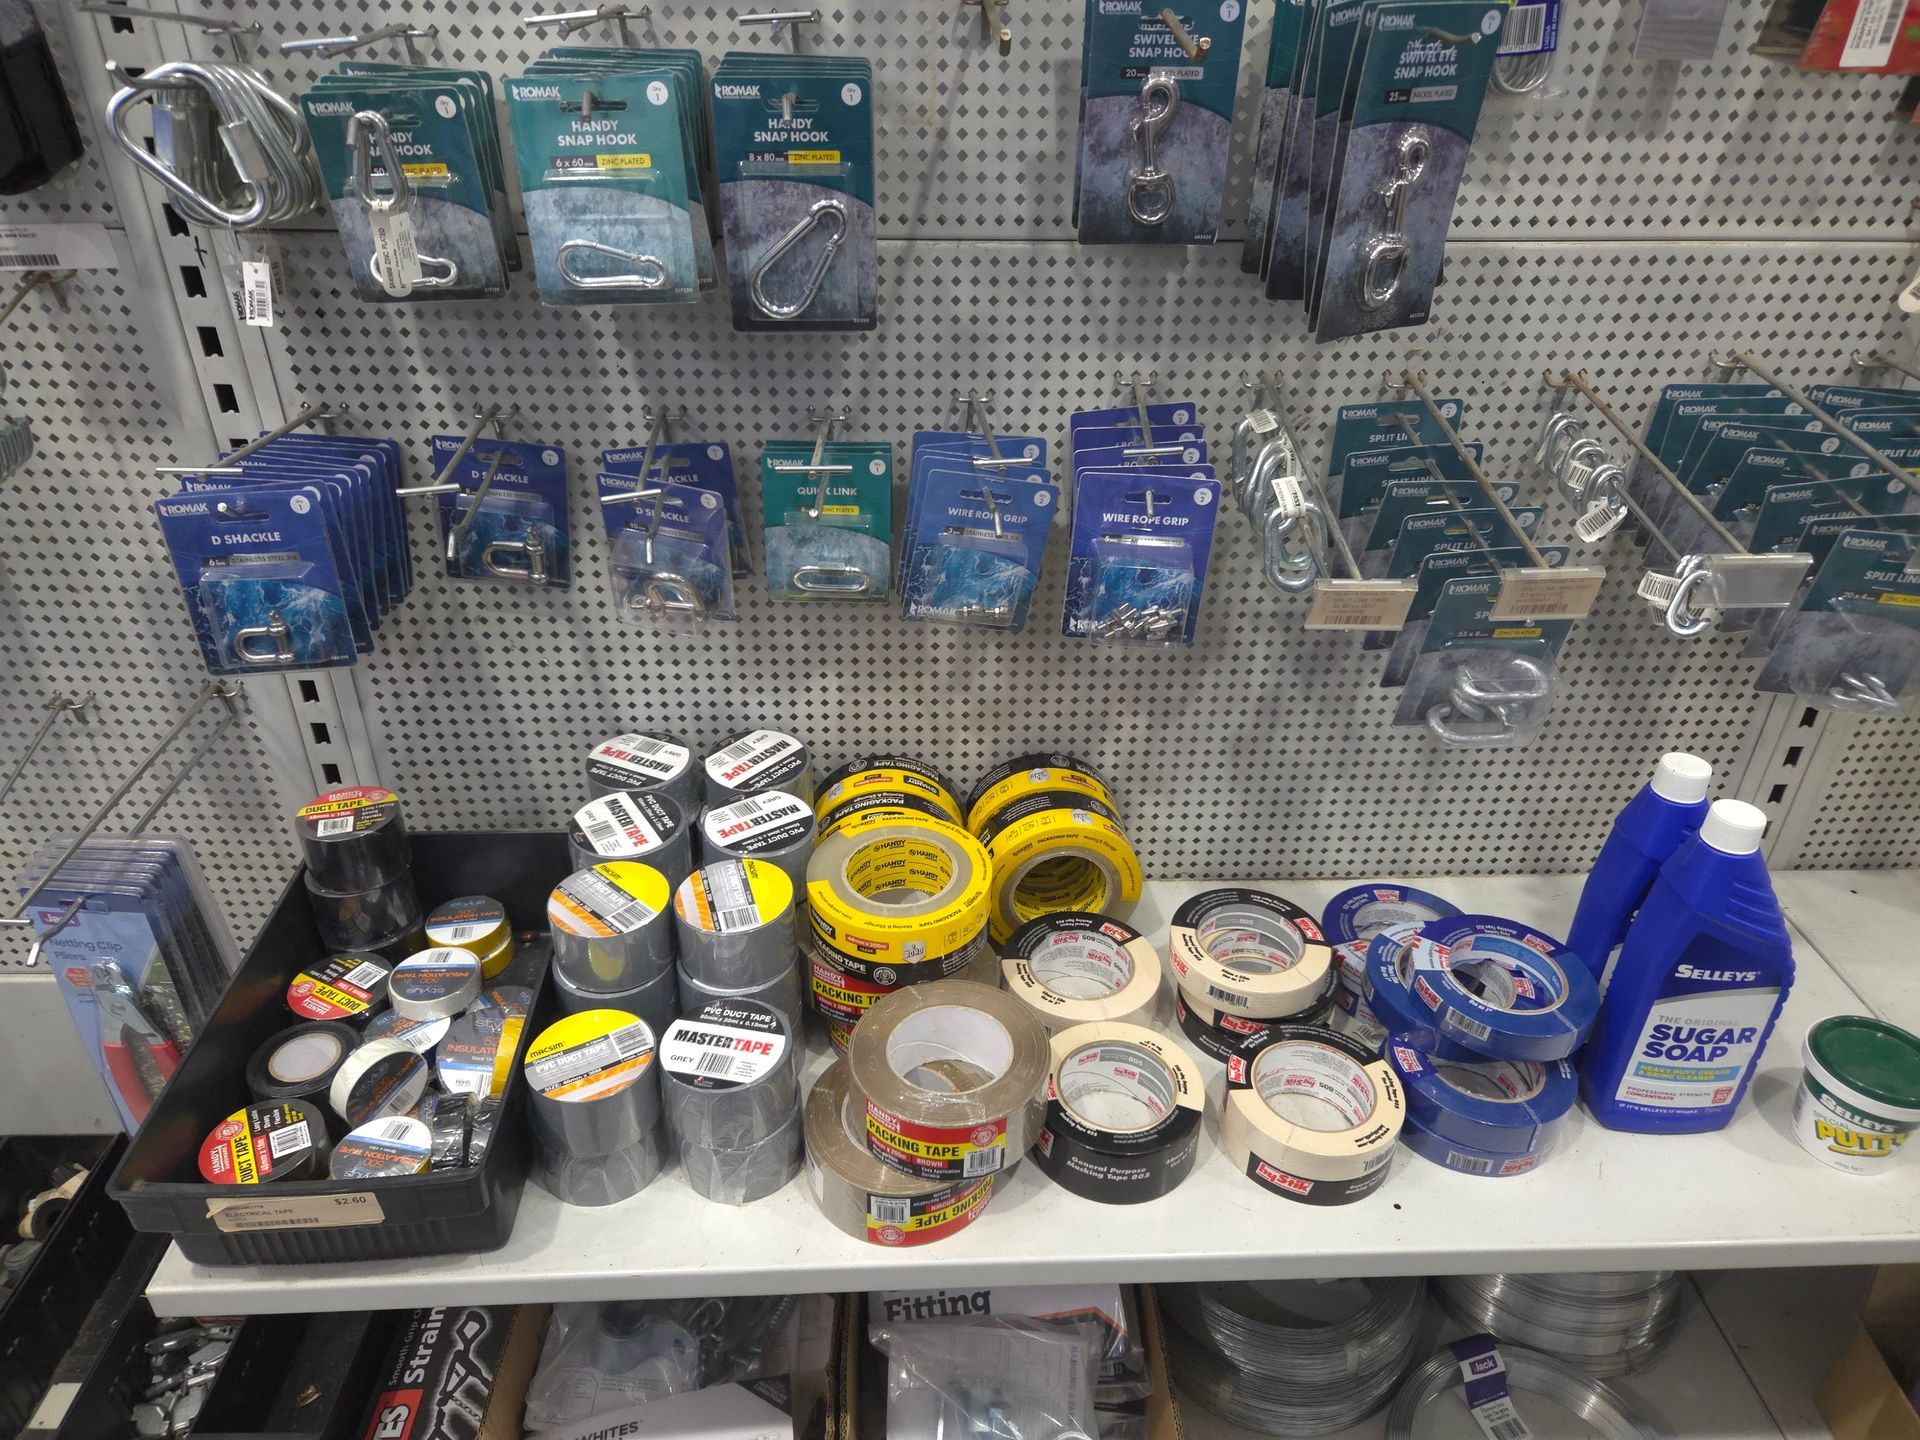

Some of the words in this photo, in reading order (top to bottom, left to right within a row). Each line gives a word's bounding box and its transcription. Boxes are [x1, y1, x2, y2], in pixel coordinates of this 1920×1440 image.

[1106, 1, 1142, 12] ROMAK
[1384, 14, 1416, 29] ROMAK
[1134, 34, 1176, 45] SWIVEL
[1129, 48, 1160, 58] SNAP
[1400, 51, 1439, 63] SWIVEL
[1440, 50, 1457, 62] EYE
[1395, 65, 1424, 79] SNAP
[1425, 64, 1458, 76] HOOK
[520, 86, 561, 98] ROMAK
[722, 85, 761, 96] ROMAK
[316, 102, 355, 115] ROMAK
[572, 120, 620, 132] HANDY
[768, 118, 814, 130] HANDY
[558, 135, 594, 147] SNAP
[597, 133, 638, 145] HOOK
[754, 131, 788, 142] SNAP
[791, 131, 830, 142] HOOK
[394, 144, 433, 155] HOOK
[621, 157, 646, 166] PLATED
[812, 153, 835, 161] PLATED
[1671, 390, 1703, 399] ROMAK
[1830, 396, 1863, 407] ROMAK
[1347, 408, 1378, 418] ROMAK
[1684, 405, 1718, 415] ROMAK
[1859, 421, 1893, 431] ROMAK
[1369, 433, 1395, 443] SPLIT
[1727, 429, 1760, 441] ROMAK
[613, 452, 643, 462] ROMAK
[1878, 449, 1904, 458] SPLIT
[773, 458, 804, 466] ROMAK
[1356, 455, 1390, 466] ROMAK
[1754, 455, 1788, 466] ROMAK
[471, 470, 480, 479] D
[833, 487, 858, 496] LINK
[1395, 486, 1431, 496] ROMAK
[1776, 489, 1814, 501] ROMAK
[168, 502, 209, 515] ROMAK
[635, 507, 643, 515] D
[948, 507, 974, 518] WIRE
[1003, 514, 1028, 524] GRIP
[1103, 513, 1130, 523] WIRE
[1132, 515, 1161, 525] ROPE
[1162, 517, 1189, 527] GRIP
[1413, 518, 1447, 529] ROMAK
[211, 535, 221, 545] D
[225, 532, 282, 544] SHACKLE
[1850, 538, 1888, 550] ROMAK
[1434, 557, 1470, 568] ROMAK
[1864, 571, 1897, 580] SPLIT
[1454, 583, 1492, 594] ROMAK
[598, 746, 675, 774] MASTERTAPE
[722, 740, 791, 782] MASTERTAPE
[873, 760, 898, 768] TAPE
[606, 771, 629, 783] DUCT
[627, 777, 642, 786] PVC
[305, 804, 334, 814] DUCT
[336, 800, 363, 811] TAPE
[855, 797, 905, 809] PACKAGING
[651, 801, 665, 817] DUCT
[661, 814, 675, 829] TAPE
[834, 806, 855, 820] TAPE
[603, 797, 651, 848] MASTERTAPE
[717, 804, 802, 839] MASTERTAPE
[787, 826, 804, 836] PVC
[765, 832, 789, 845] DUCT
[881, 840, 906, 849] HANDY
[917, 849, 939, 861] HANDY
[882, 860, 906, 868] HANDY
[917, 871, 939, 881] HANDY
[582, 873, 597, 886] PVC
[594, 880, 611, 895] DUCT
[606, 890, 625, 905] TAPE
[884, 879, 907, 888] HANDY
[476, 910, 501, 918] TAPE
[1239, 918, 1255, 926] 805
[50, 939, 96, 951] Netting
[97, 942, 123, 954] Clip
[843, 959, 867, 972] TAPE
[813, 965, 843, 980] HANDY
[1674, 963, 1758, 982] SELLEYS
[315, 985, 338, 1002] TAPE
[815, 981, 864, 1005] PACKING
[338, 995, 361, 1011] DUCT
[704, 1006, 722, 1016] PVC
[722, 1008, 748, 1019] DUCT
[749, 1012, 772, 1022] TAPE
[1658, 1015, 1682, 1025] THE
[1684, 1017, 1741, 1027] ORIGINAL
[1648, 1023, 1758, 1046] SUGAR
[674, 1028, 774, 1056] MASTERTAPE
[529, 1040, 565, 1059] macsim
[1642, 1041, 1730, 1062] SOAP
[535, 1060, 556, 1074] PVC
[556, 1053, 586, 1067] DUCT
[587, 1043, 610, 1057] TAPE
[670, 1053, 695, 1065] GREY
[1128, 1056, 1144, 1066] 805
[1625, 1090, 1675, 1101] CONCENTRATE
[1627, 1086, 1678, 1097] PROFESSIONAL
[867, 1101, 898, 1125] HANDY
[1819, 1092, 1898, 1133] SELLEYS
[868, 1119, 921, 1153] PACKING
[924, 1144, 961, 1158] TAPE
[234, 1135, 249, 1159] TAPE
[916, 1157, 944, 1168] BROWN
[1071, 1156, 1108, 1173] General
[1109, 1165, 1148, 1175] Purpose
[240, 1159, 254, 1183] DUCT
[1066, 1160, 1105, 1180] Masking
[1106, 1173, 1129, 1182] Tape
[1131, 1172, 1151, 1181] 805
[1257, 1162, 1313, 1195] hyStik
[334, 1197, 367, 1206] $2.60
[952, 1175, 993, 1217] PACKING
[225, 1210, 272, 1218] ELECTRICAL
[915, 1211, 949, 1229] TAPE
[882, 1290, 992, 1322] Fitting
[387, 1352, 409, 1387] Smooth
[403, 1323, 416, 1352] Grip
[1473, 1357, 1497, 1374] Jack
